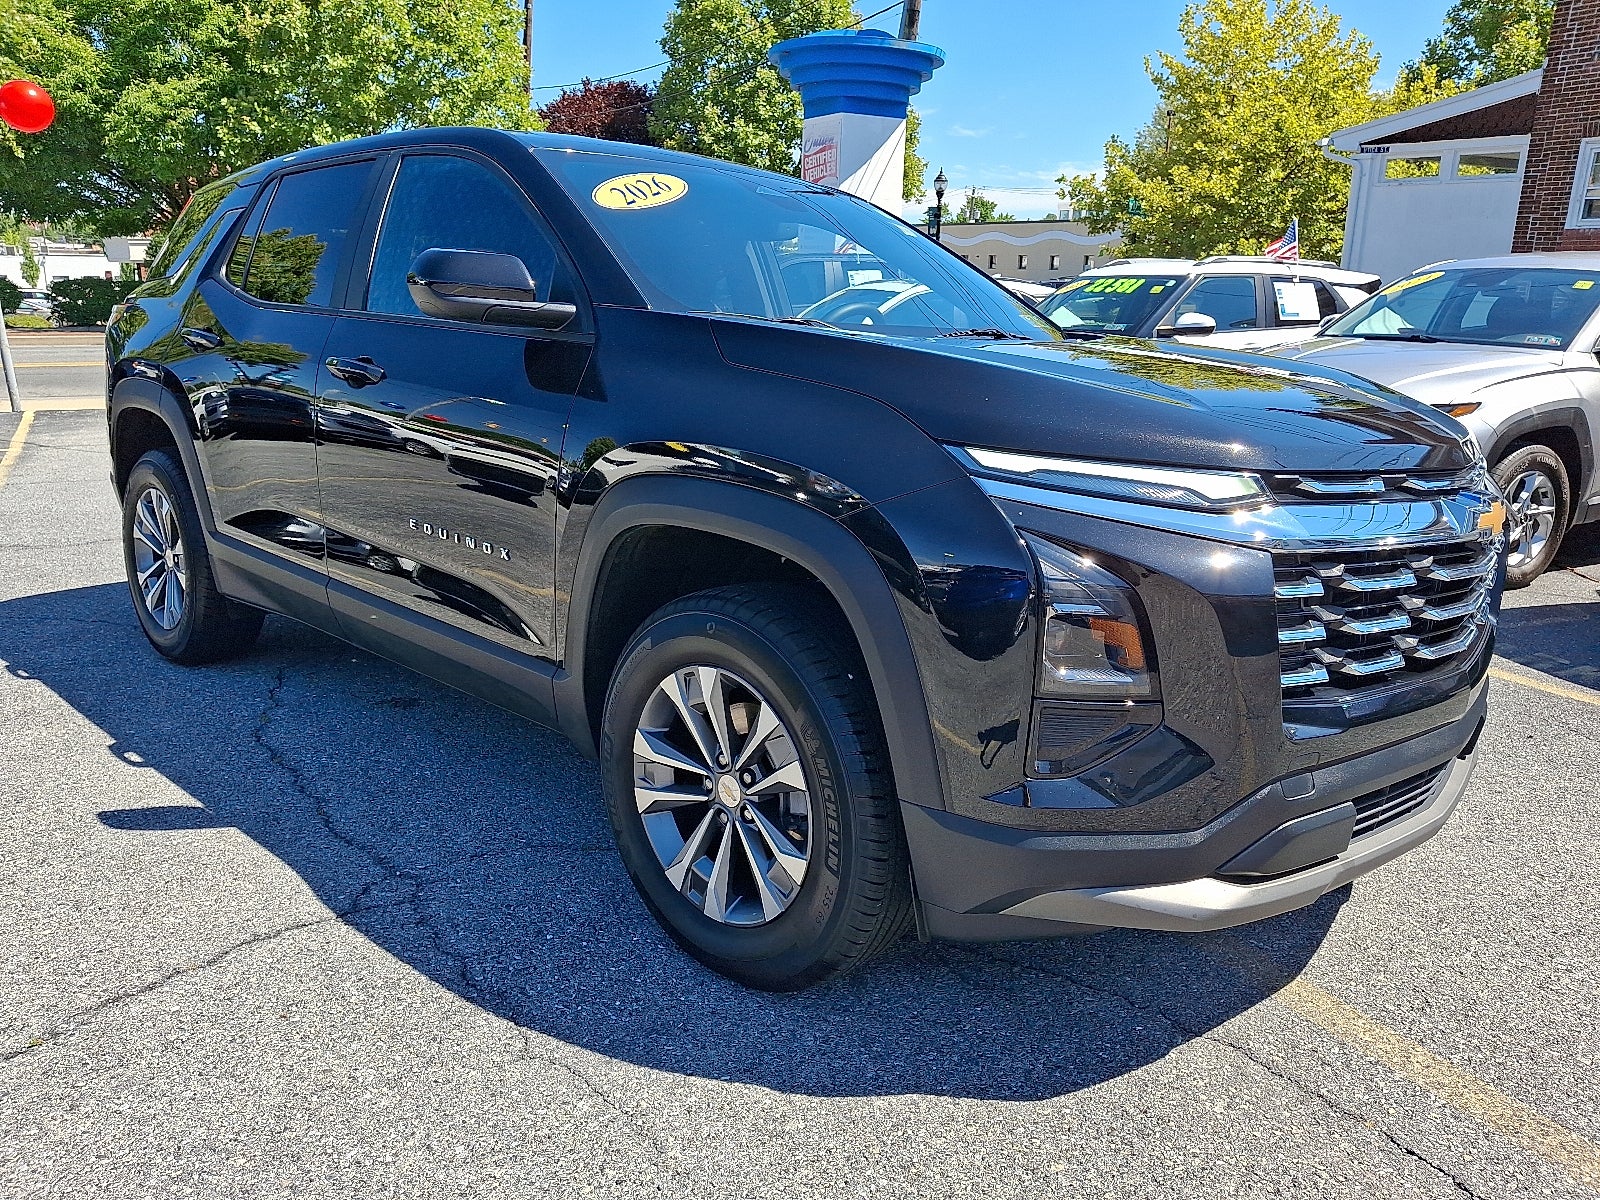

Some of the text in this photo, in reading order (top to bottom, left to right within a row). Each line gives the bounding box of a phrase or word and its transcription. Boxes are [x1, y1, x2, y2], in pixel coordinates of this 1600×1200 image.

[804, 148, 837, 170] CERTIFIED
[804, 162, 837, 182] VEHICLES
[609, 175, 672, 206] 2026
[1536, 455, 1559, 470] KUMHO
[408, 518, 511, 561] EQUINOX
[814, 757, 839, 873] MICHELIN
